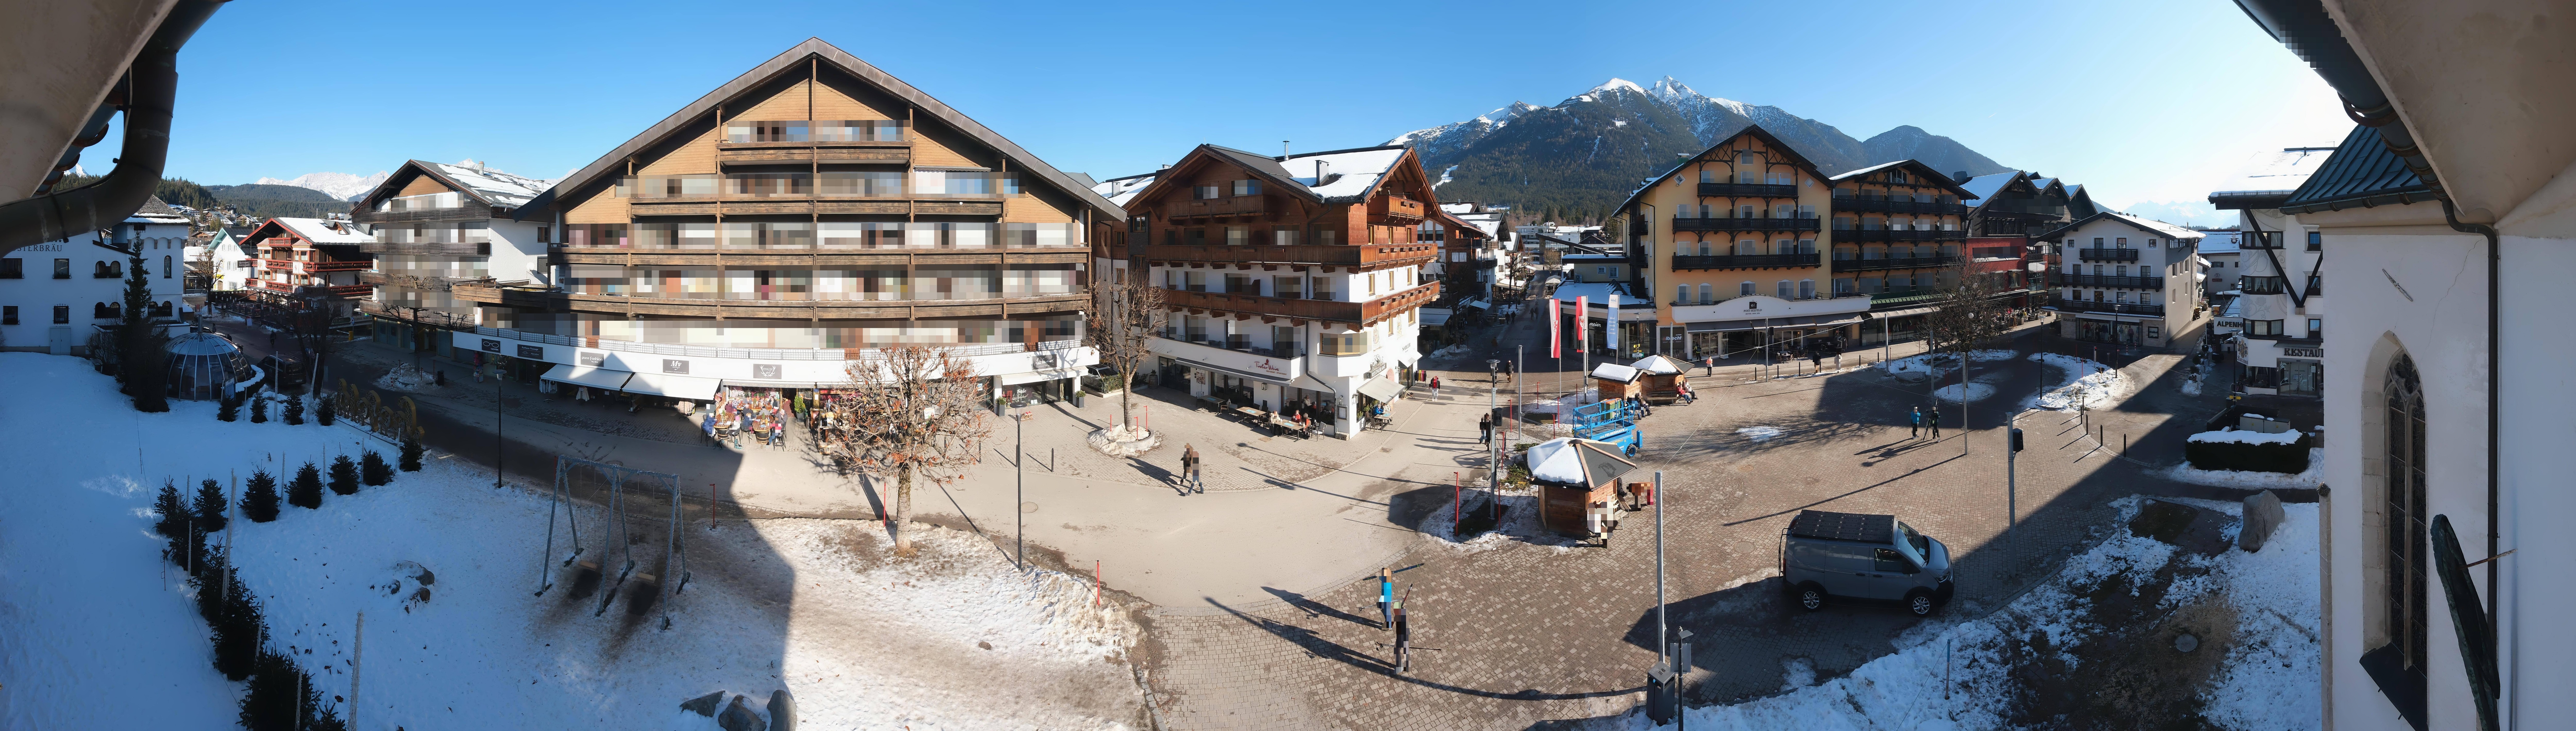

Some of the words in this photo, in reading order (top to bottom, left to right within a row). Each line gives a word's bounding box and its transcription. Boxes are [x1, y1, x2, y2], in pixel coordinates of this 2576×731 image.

[2237, 355, 2248, 364] Kaltschmid
[670, 361, 682, 370] My
[1372, 364, 1386, 377] RESTAURANT
